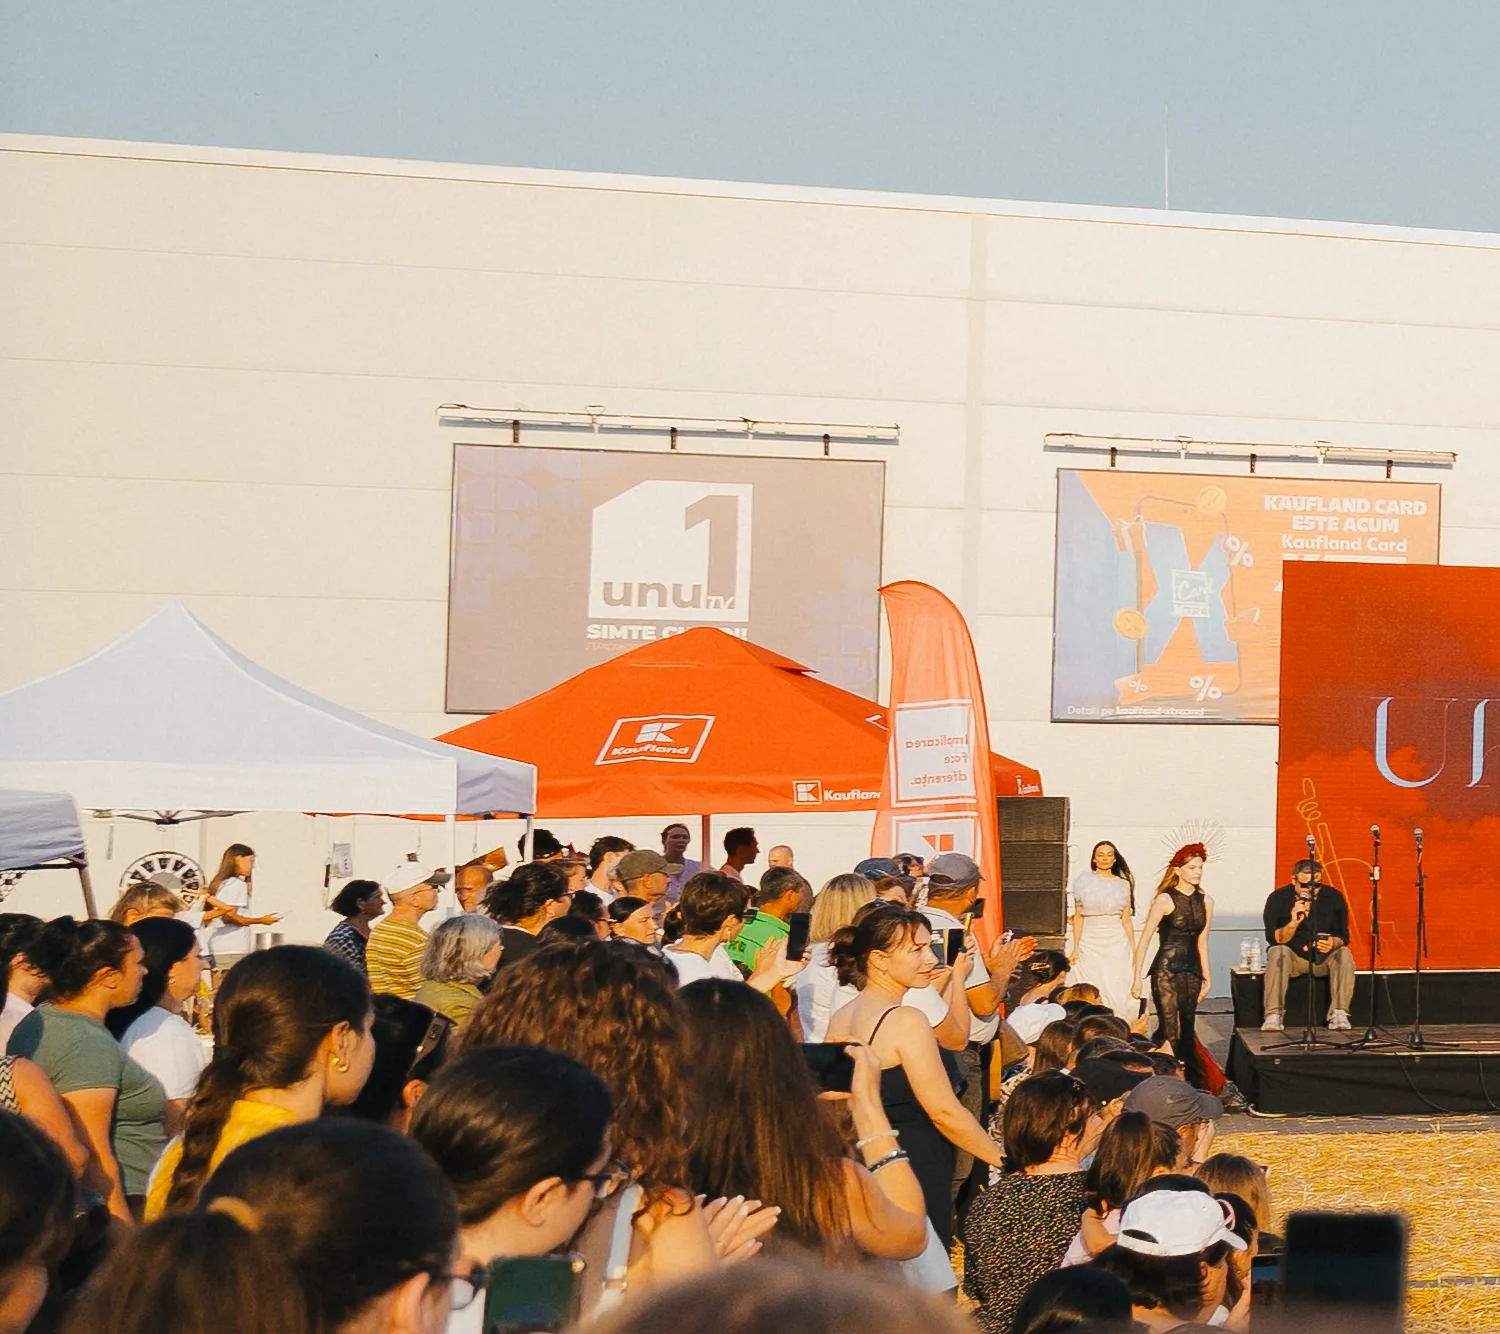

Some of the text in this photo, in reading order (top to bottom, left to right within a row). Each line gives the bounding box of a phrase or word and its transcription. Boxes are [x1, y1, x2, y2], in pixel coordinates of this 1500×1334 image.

[1264, 495, 1428, 516] KAUFLAND CARD
[1292, 516, 1399, 533] ESTE ACUM
[1282, 534, 1407, 552] Kaufland Card
[603, 581, 702, 609] unu
[586, 624, 656, 640] SIMTE
[611, 744, 690, 756] Kaufland
[824, 788, 882, 801] Kauflan
